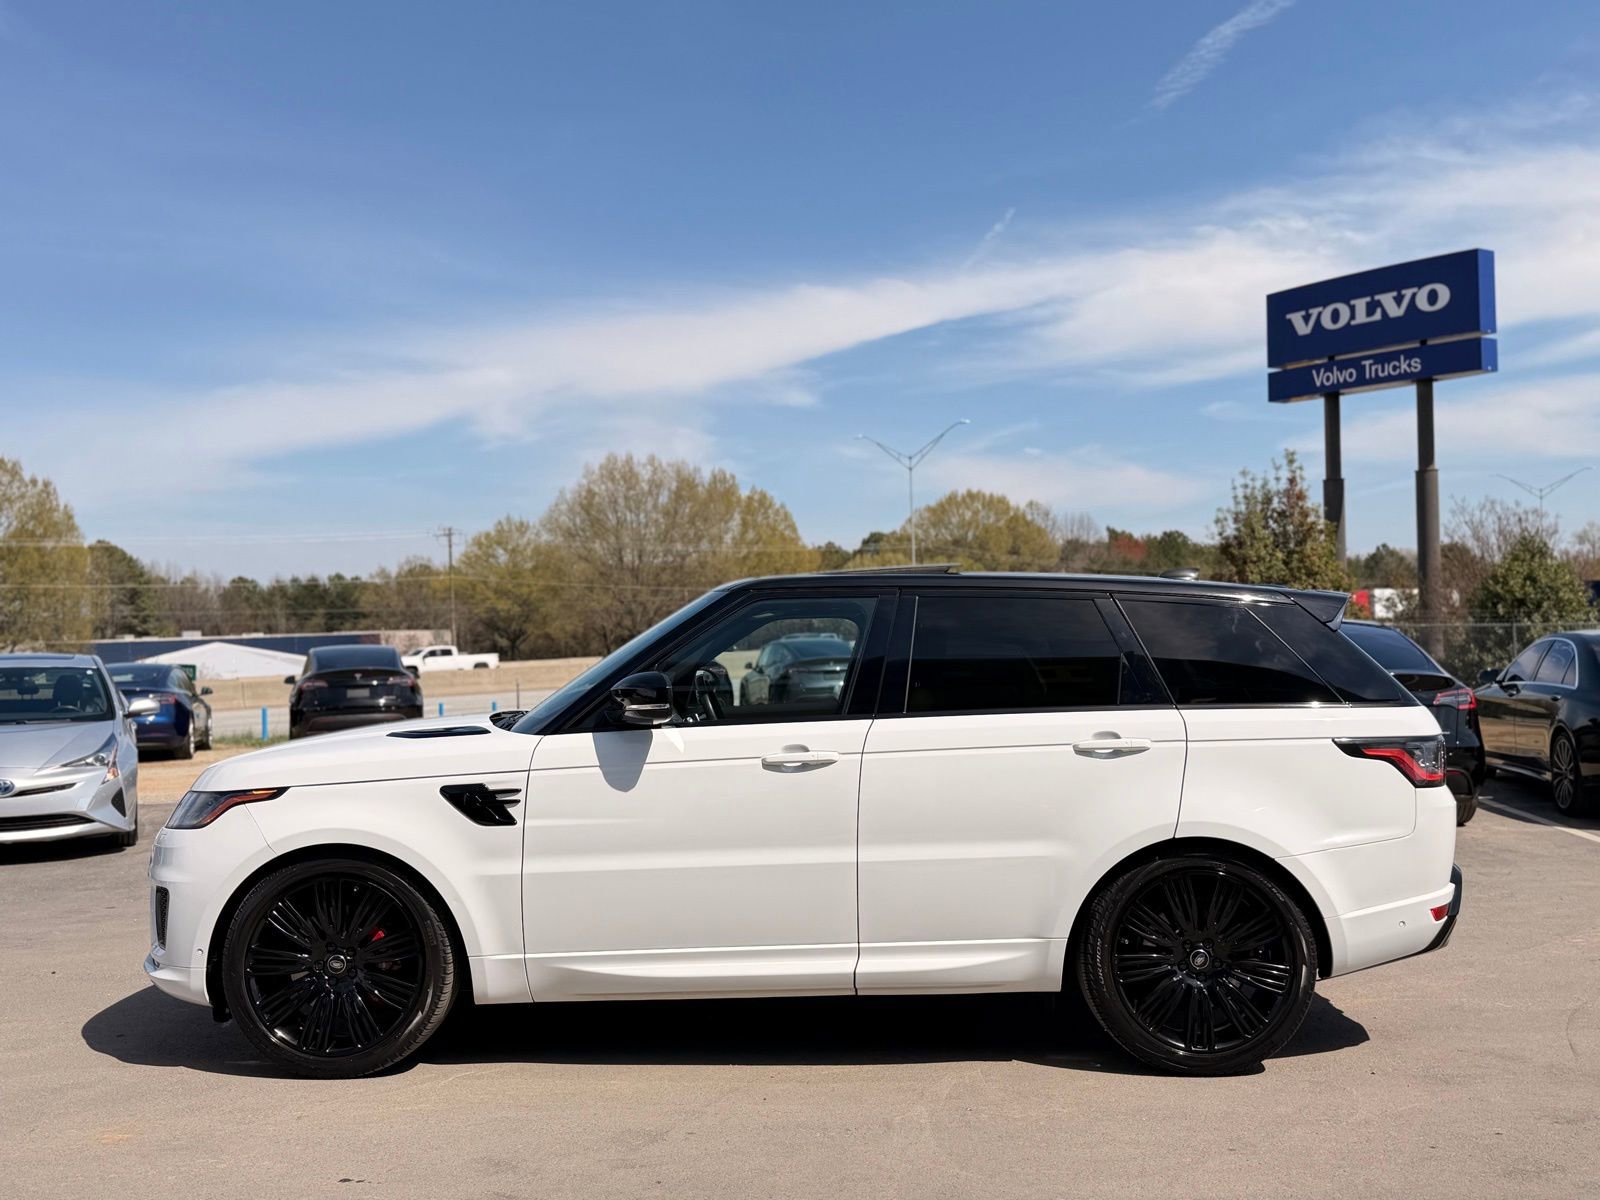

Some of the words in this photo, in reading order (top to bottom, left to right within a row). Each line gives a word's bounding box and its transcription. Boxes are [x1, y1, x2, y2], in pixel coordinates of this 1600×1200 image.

[1286, 283, 1450, 336] VOLVO
[1312, 366, 1357, 387] Volvo
[1361, 355, 1422, 380] Trucks
